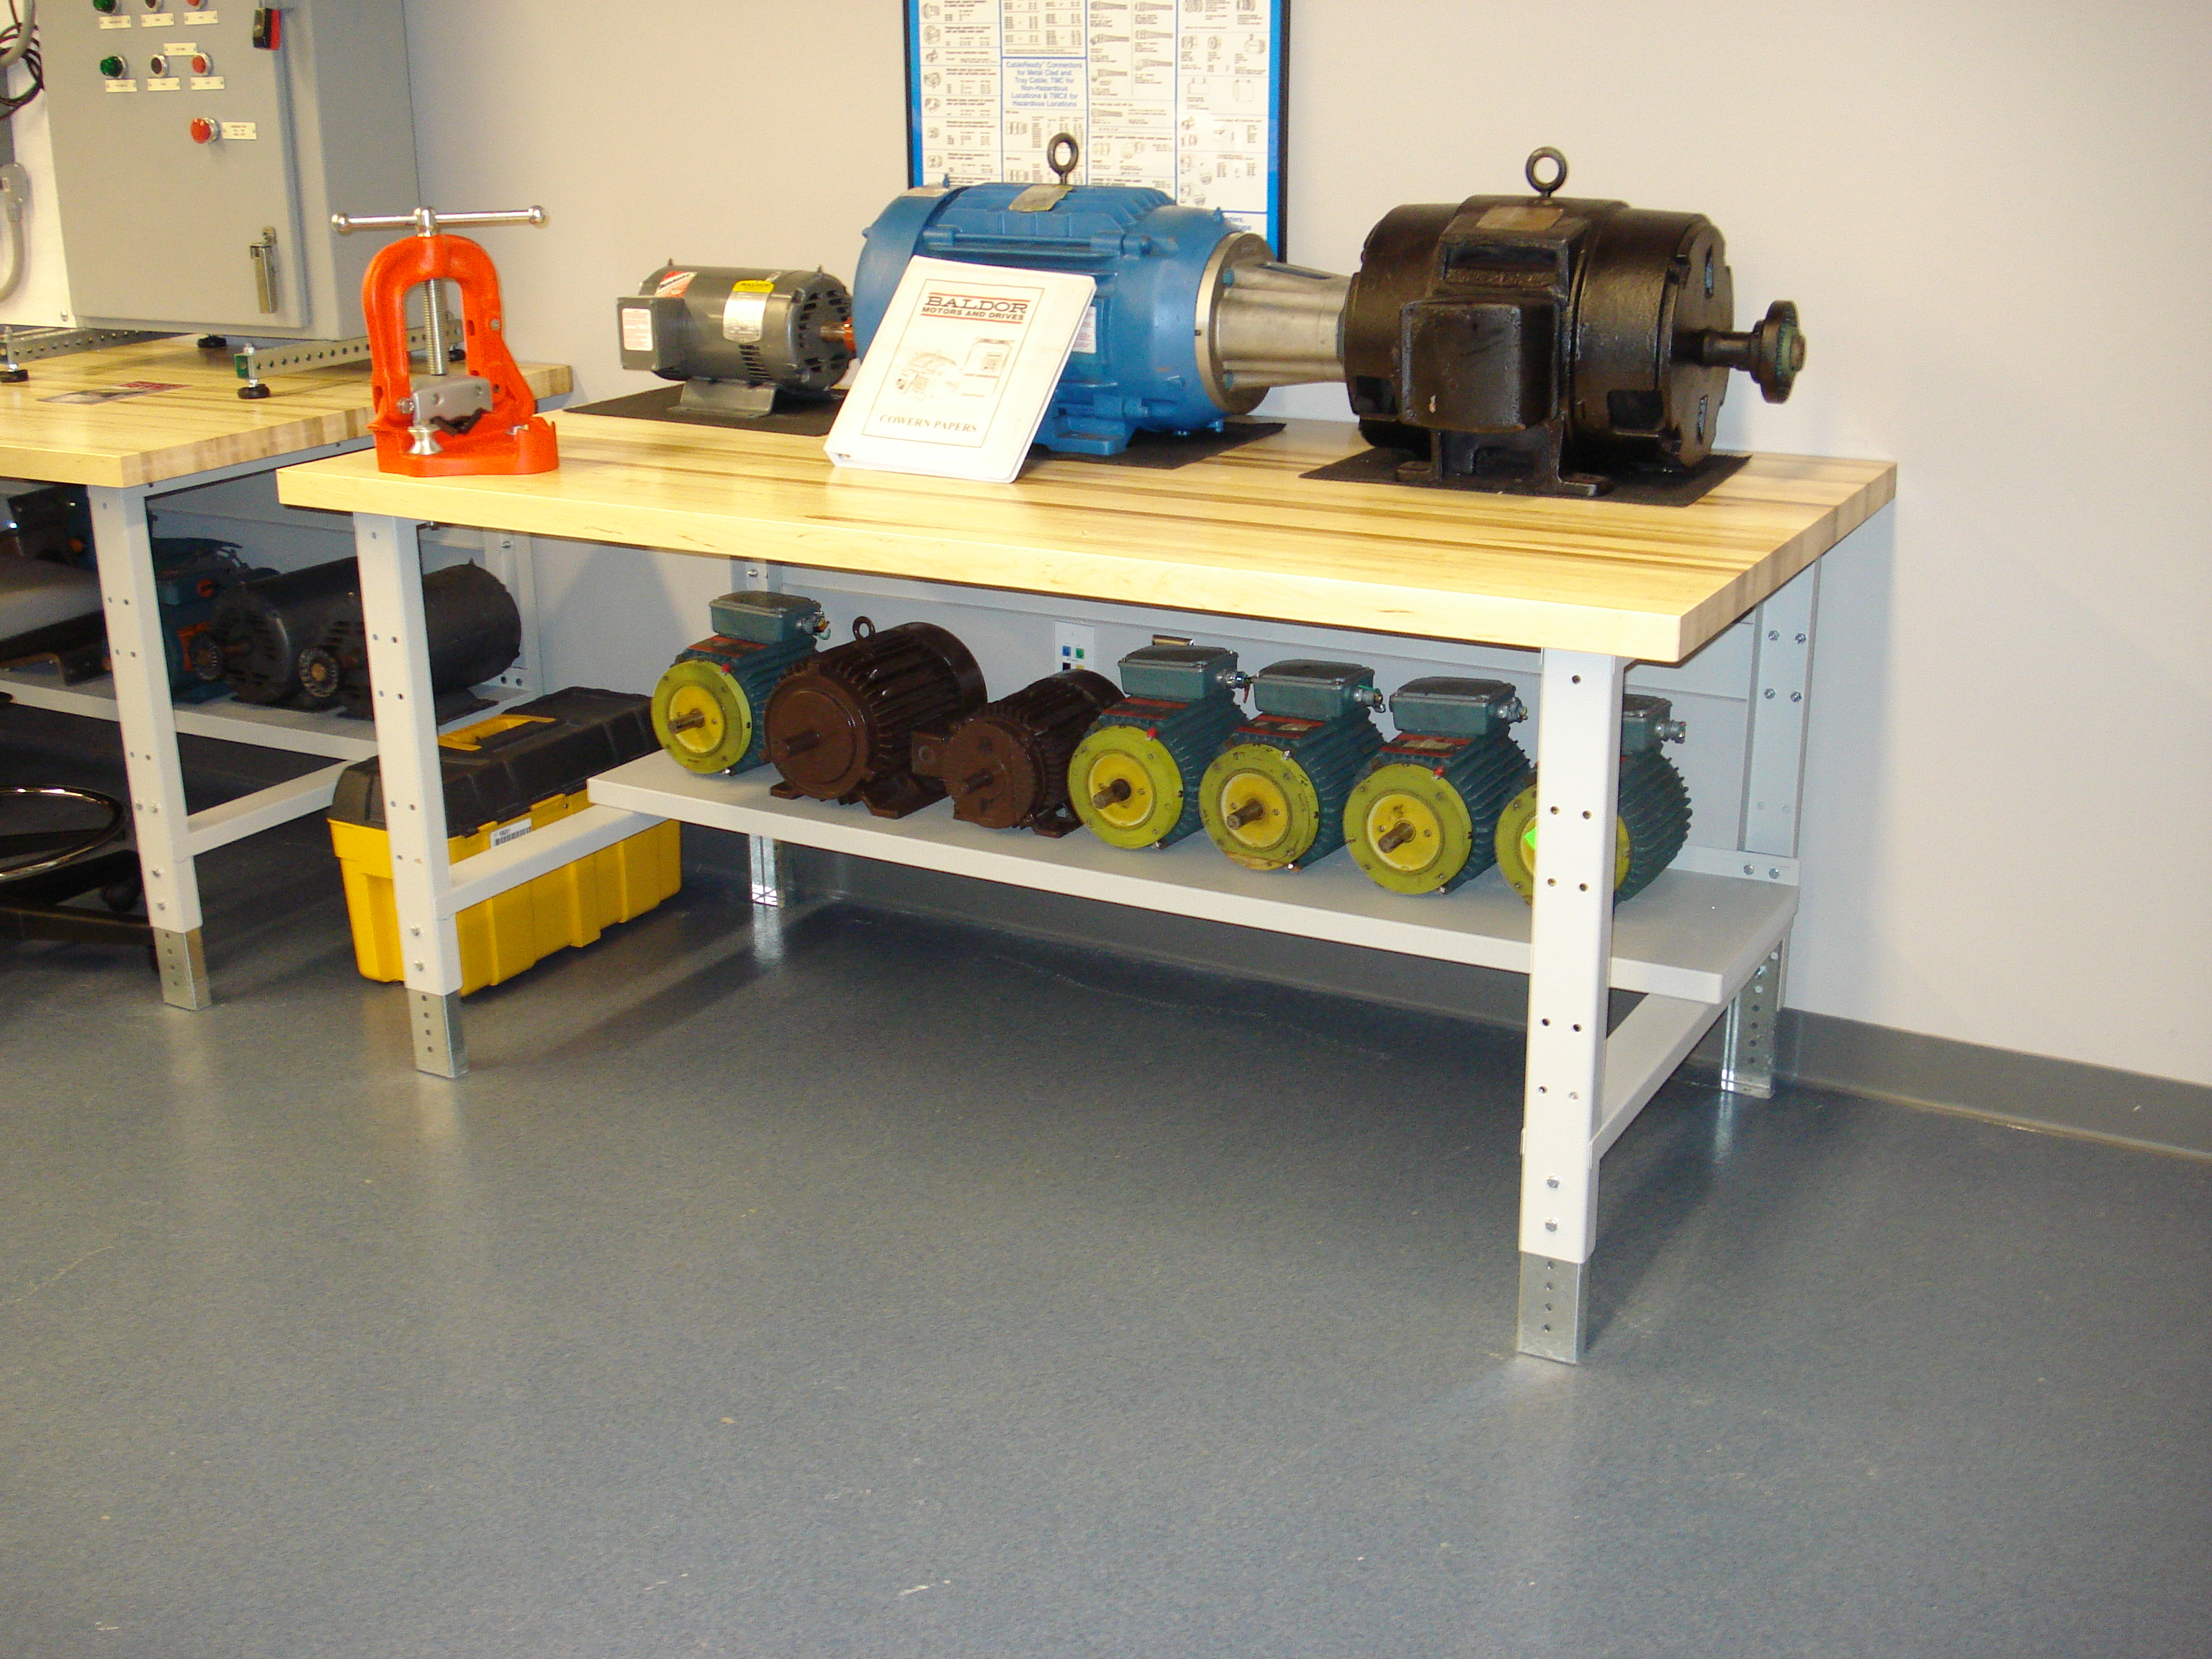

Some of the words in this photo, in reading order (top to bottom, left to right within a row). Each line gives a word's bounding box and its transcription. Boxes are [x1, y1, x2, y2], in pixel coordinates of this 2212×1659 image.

[922, 306, 963, 316] MOTORS
[989, 312, 1024, 321] DRIVES
[924, 296, 1028, 314] BALDOR
[879, 414, 931, 427] COWERN
[933, 421, 978, 433] PAPERS
